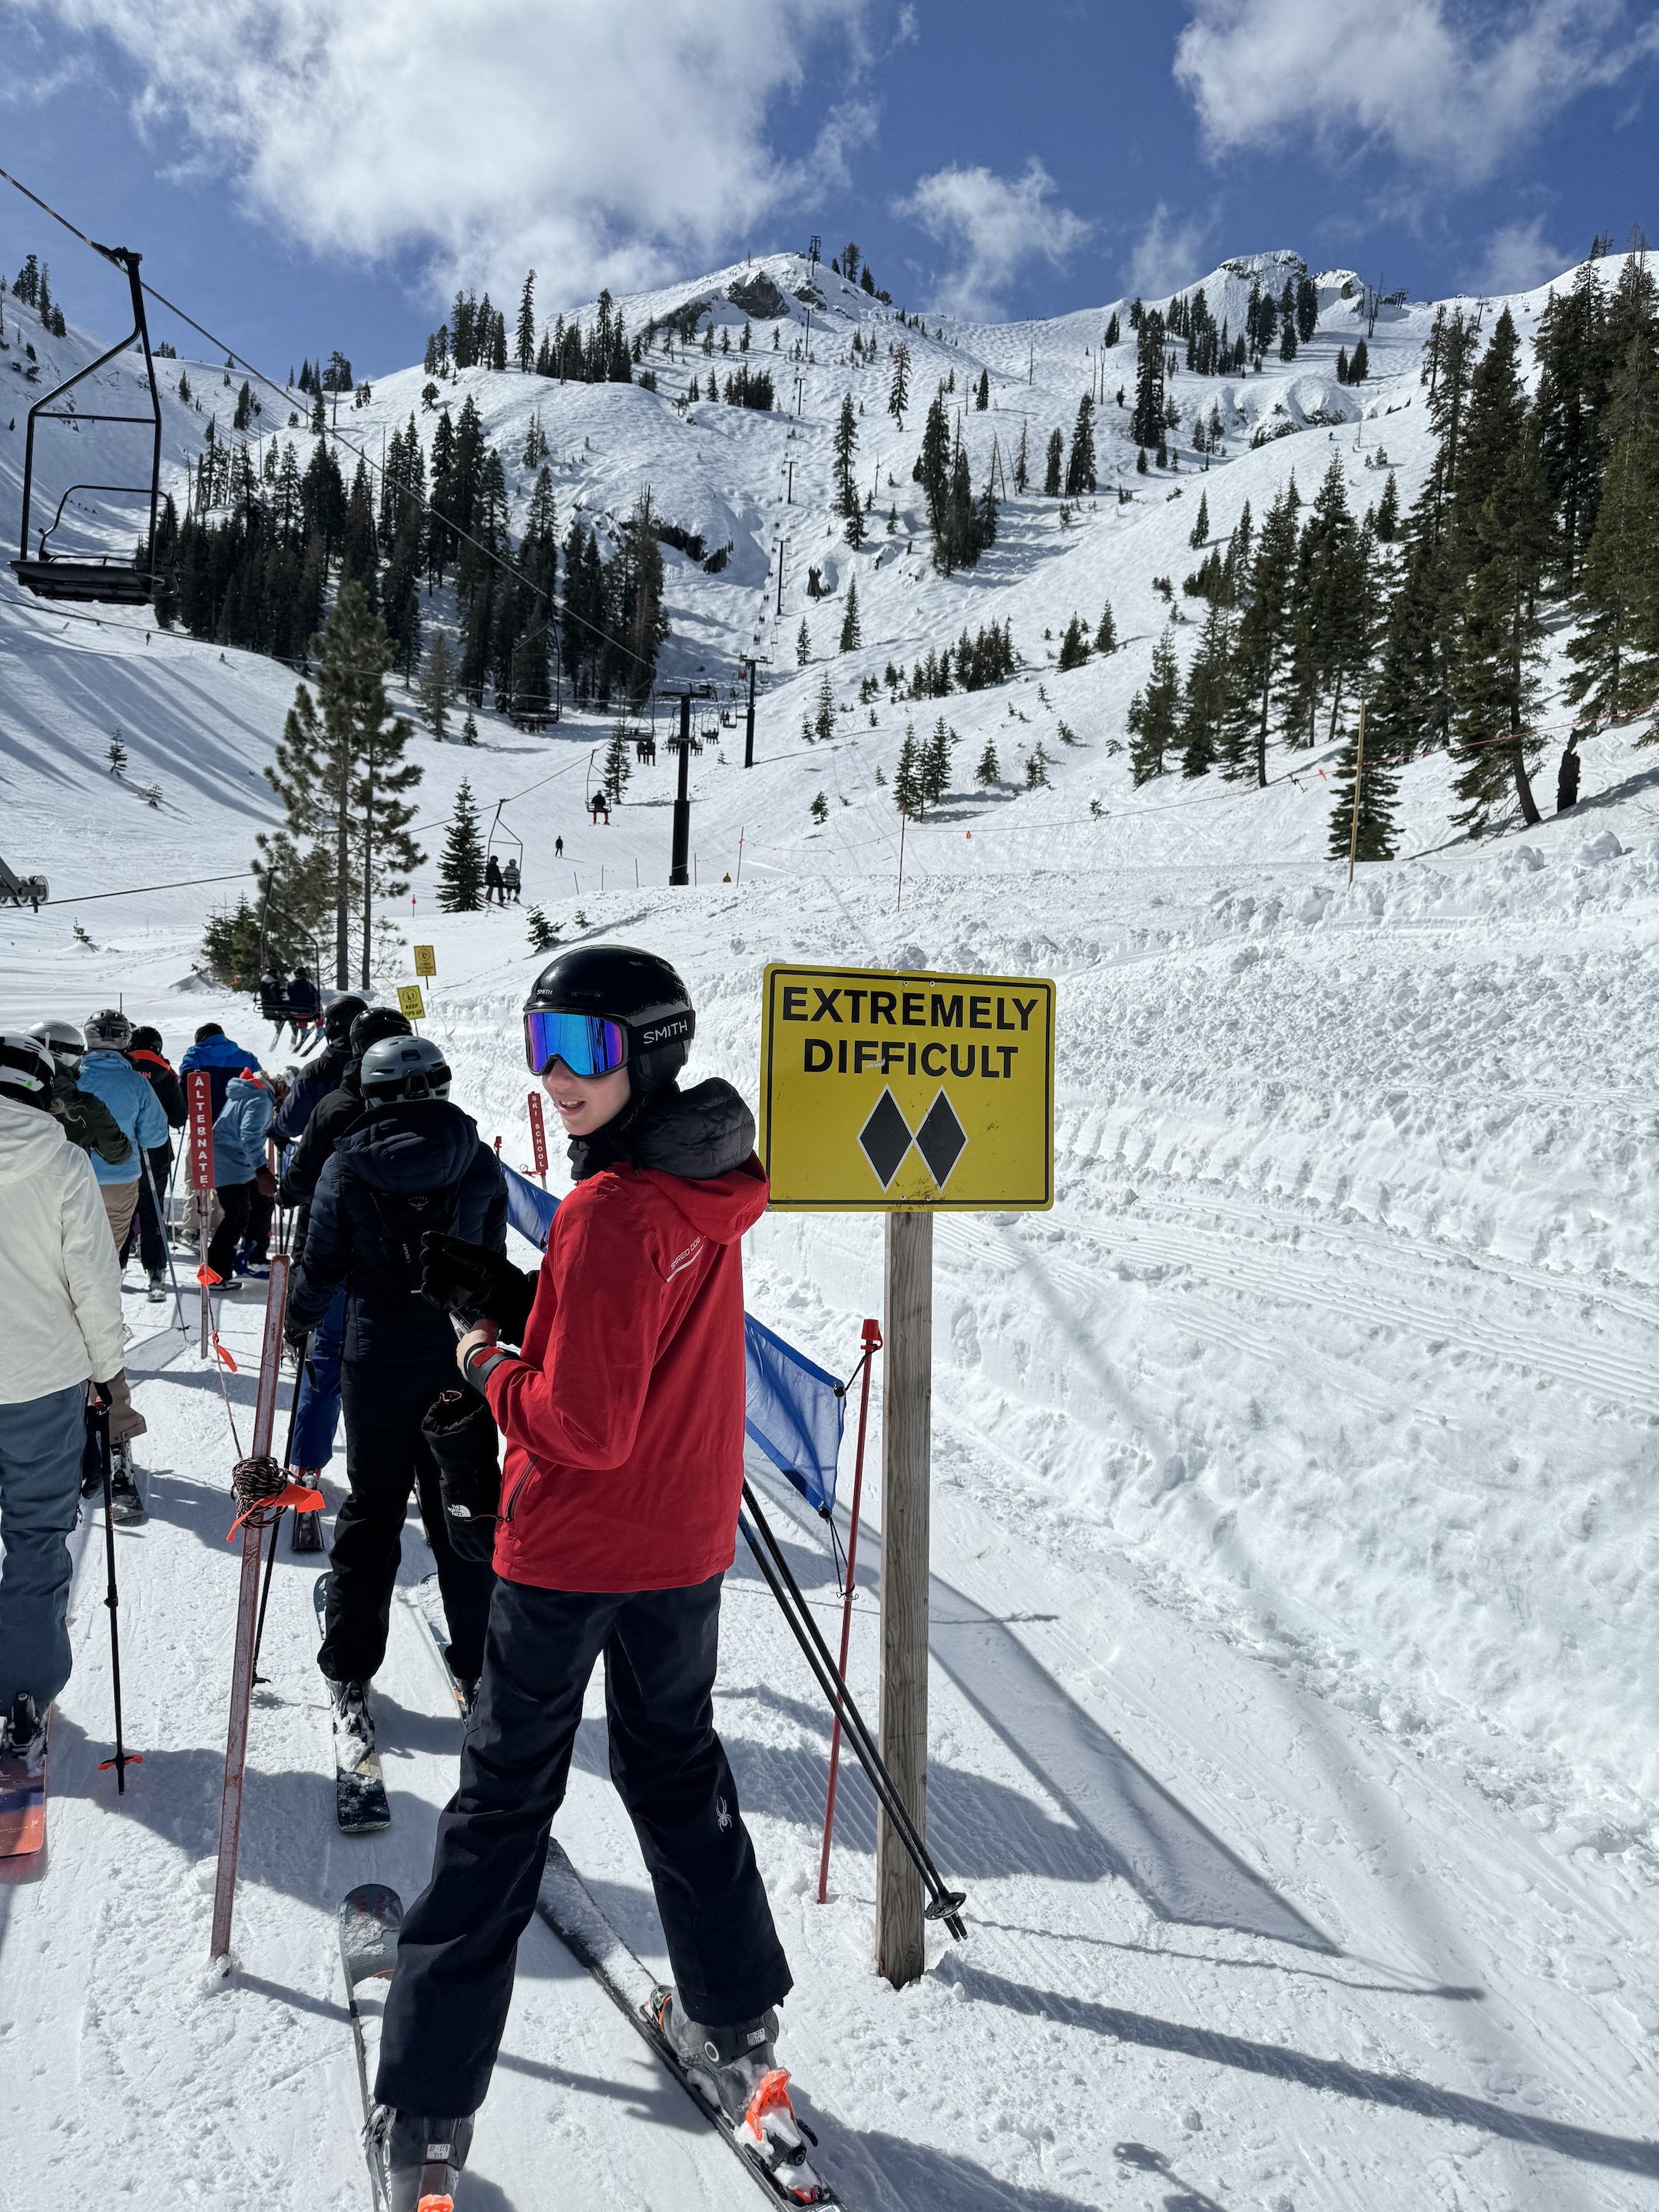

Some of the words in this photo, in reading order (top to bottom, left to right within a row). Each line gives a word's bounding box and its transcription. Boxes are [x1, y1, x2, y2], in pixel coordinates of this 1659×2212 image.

[783, 986, 1039, 1031] EXTREMELY
[643, 1019, 687, 1044] SMITH
[803, 1038, 1018, 1078] DIFFICULT
[194, 1076, 208, 1184] ALTERNATE
[535, 1124, 544, 1167] SCHOOL
